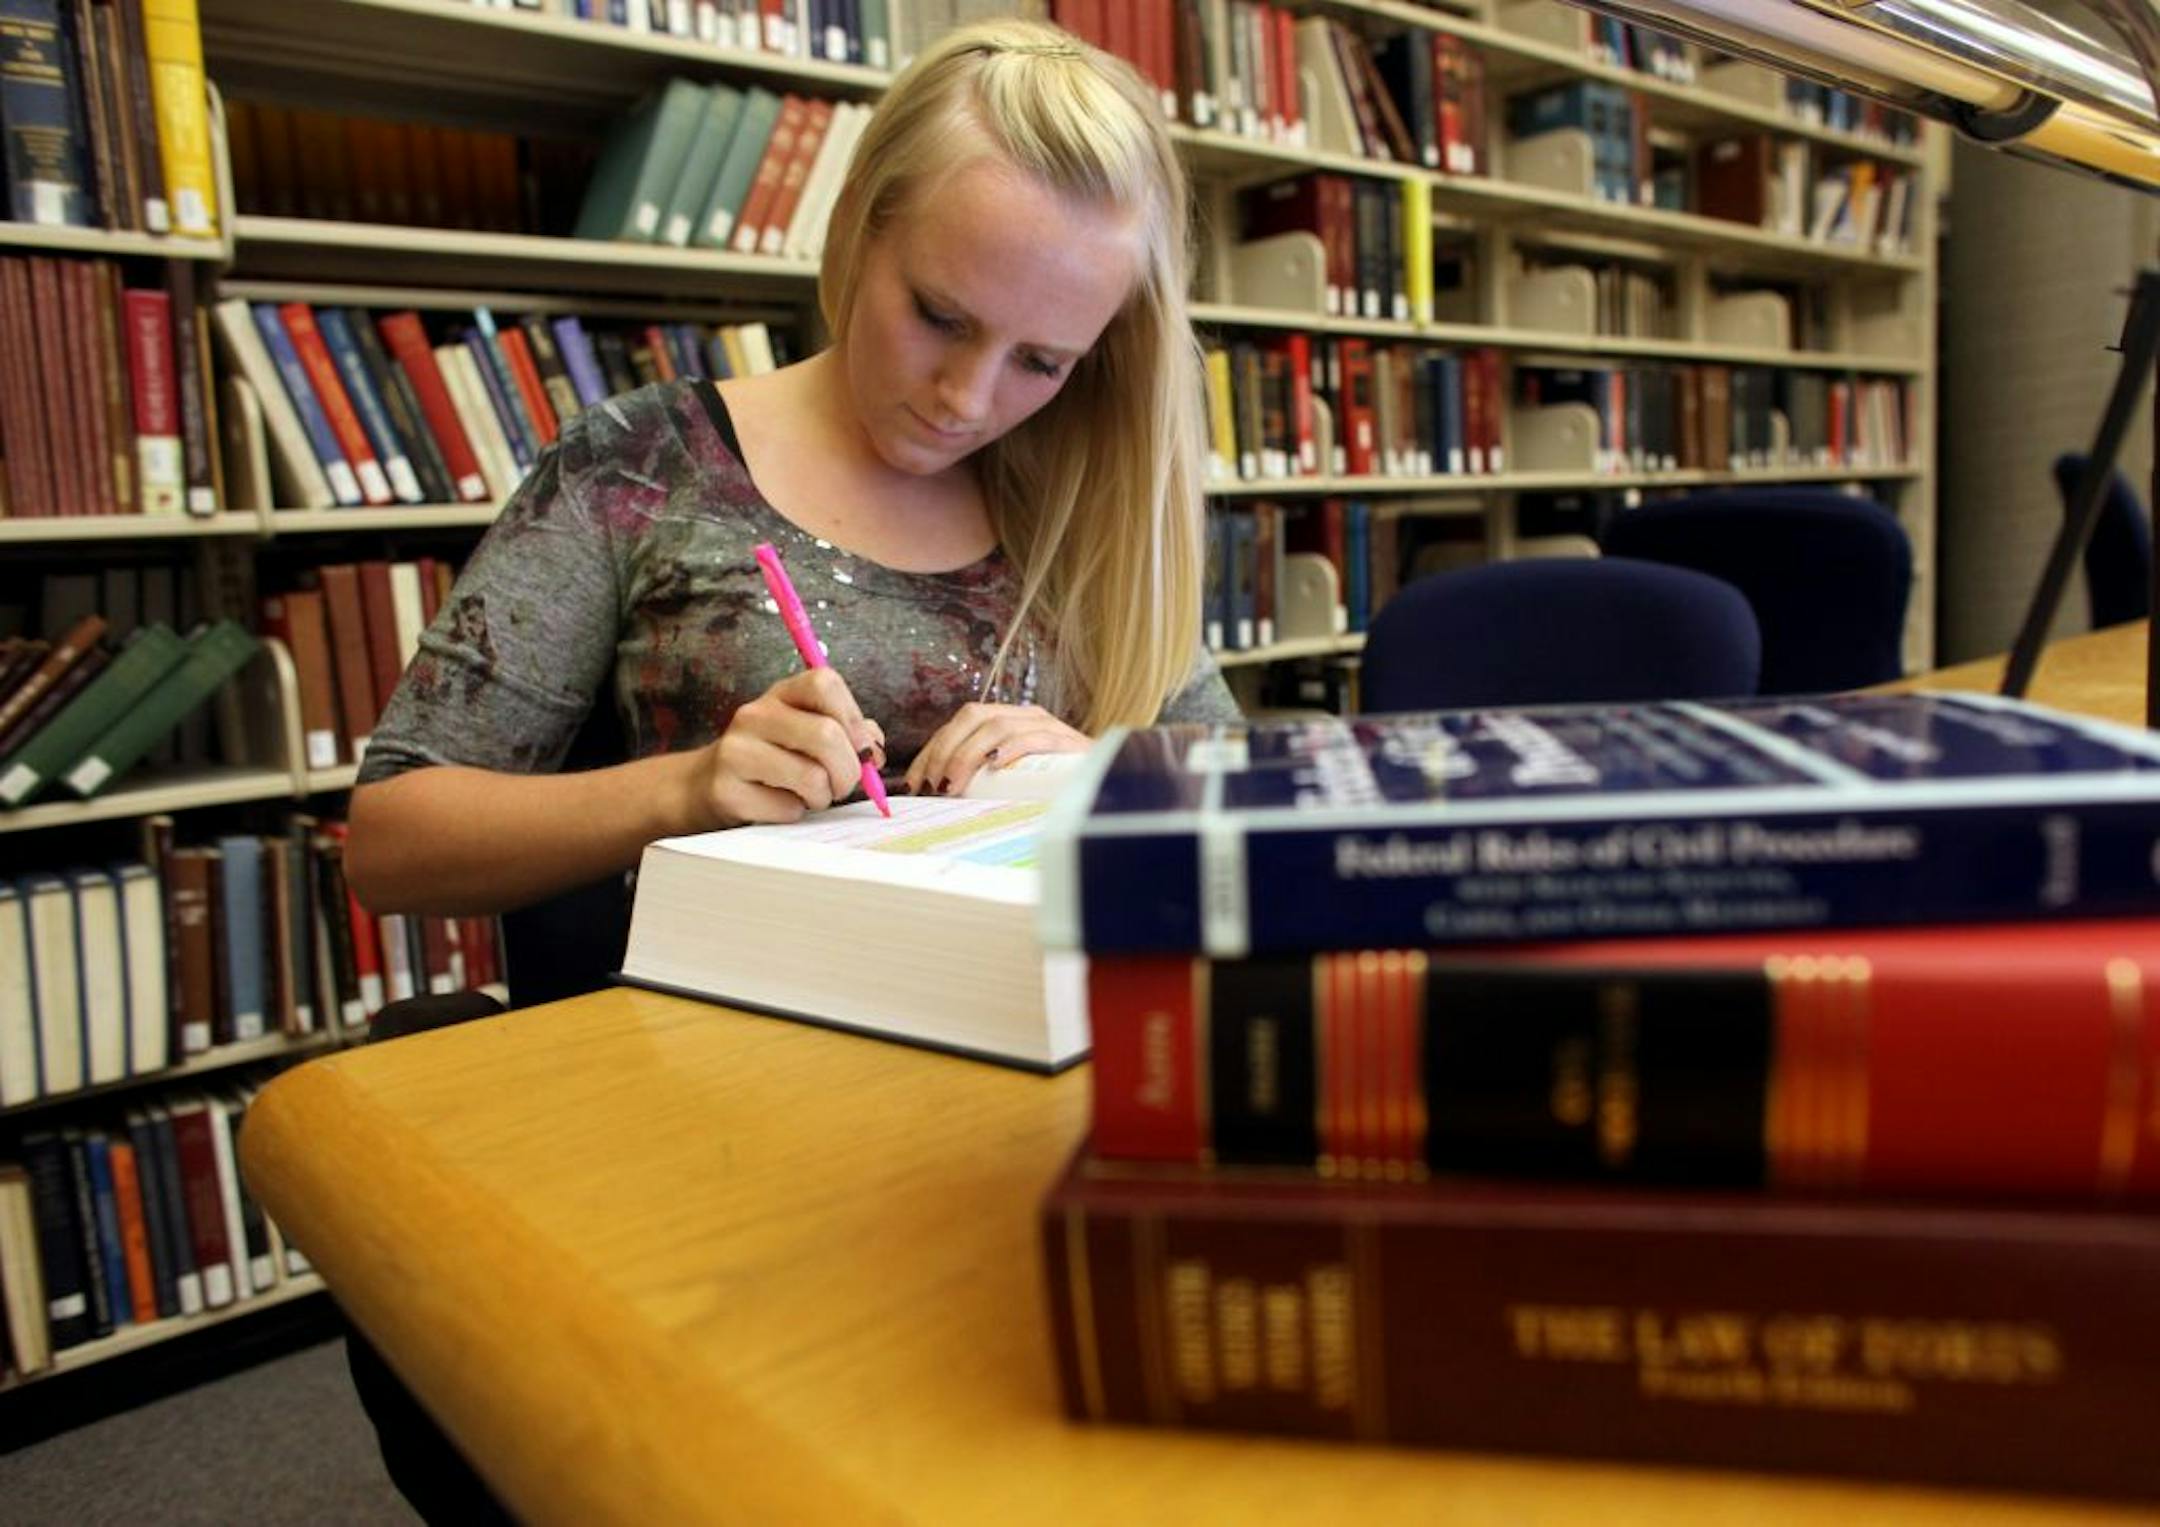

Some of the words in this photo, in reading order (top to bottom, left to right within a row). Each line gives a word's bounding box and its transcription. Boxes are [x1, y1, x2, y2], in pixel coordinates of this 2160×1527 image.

[1334, 832, 1472, 878] Federal
[1475, 830, 1580, 871] Rules
[1582, 824, 1628, 868] of
[1630, 823, 1726, 867] Civil
[1728, 819, 1918, 863] Procedure
[1509, 1306, 1620, 1362] THE
[1635, 1308, 1750, 1370] LAW
[1763, 1312, 1842, 1373] OF
